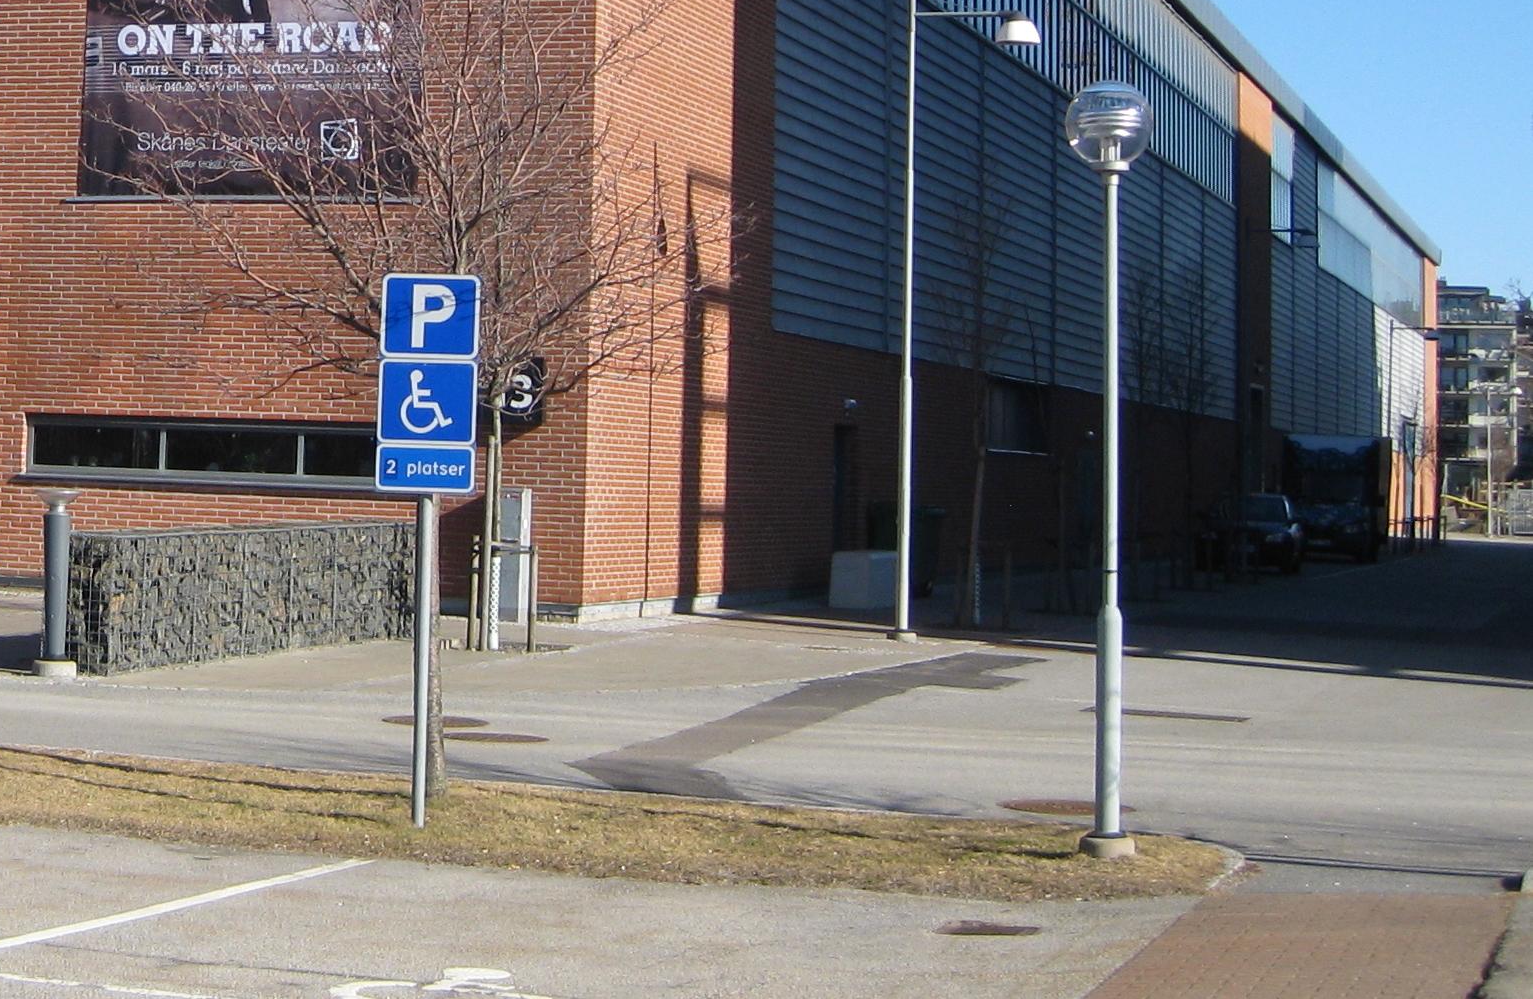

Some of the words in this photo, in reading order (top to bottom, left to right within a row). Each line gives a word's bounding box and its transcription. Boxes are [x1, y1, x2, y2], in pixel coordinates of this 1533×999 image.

[117, 23, 177, 56] ON
[186, 22, 267, 55] THE
[277, 21, 393, 54] ROAD
[130, 64, 169, 76] mars
[182, 60, 191, 75] 6
[195, 60, 224, 78] maj
[252, 59, 309, 75] Sånes
[136, 130, 207, 152] Skånes
[410, 283, 457, 348] P
[385, 459, 397, 474] 2
[406, 460, 466, 478] platser
